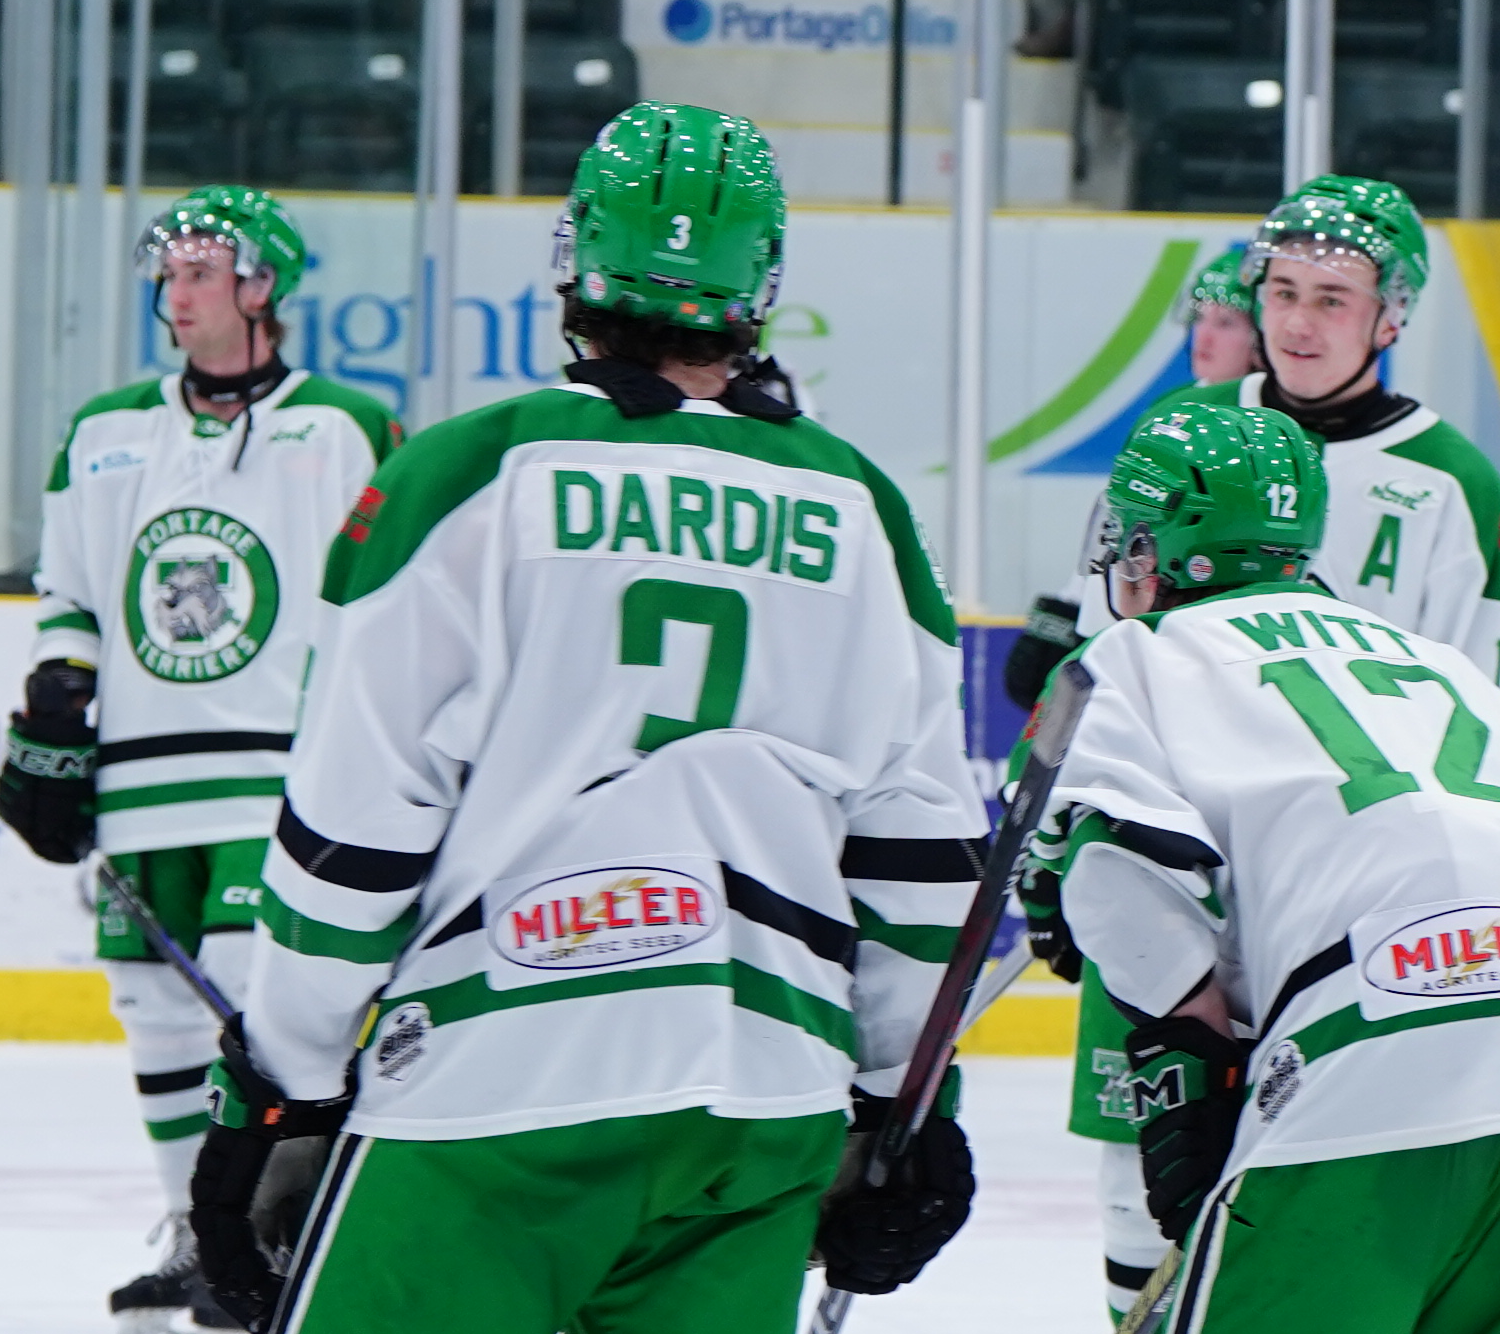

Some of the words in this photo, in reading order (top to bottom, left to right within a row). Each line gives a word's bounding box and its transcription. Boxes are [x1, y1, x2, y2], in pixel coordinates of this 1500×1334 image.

[666, 214, 694, 251] 3
[1126, 478, 1170, 504] CCM
[1266, 482, 1298, 519] 12
[134, 510, 260, 559] PORTAGE
[551, 469, 840, 585] DARDIS
[1357, 512, 1401, 595] A
[135, 633, 259, 680] TERRIERS
[1226, 609, 1421, 660] WITT
[617, 576, 750, 753] 3
[511, 886, 708, 949] MILLER
[628, 934, 687, 951] SEED
